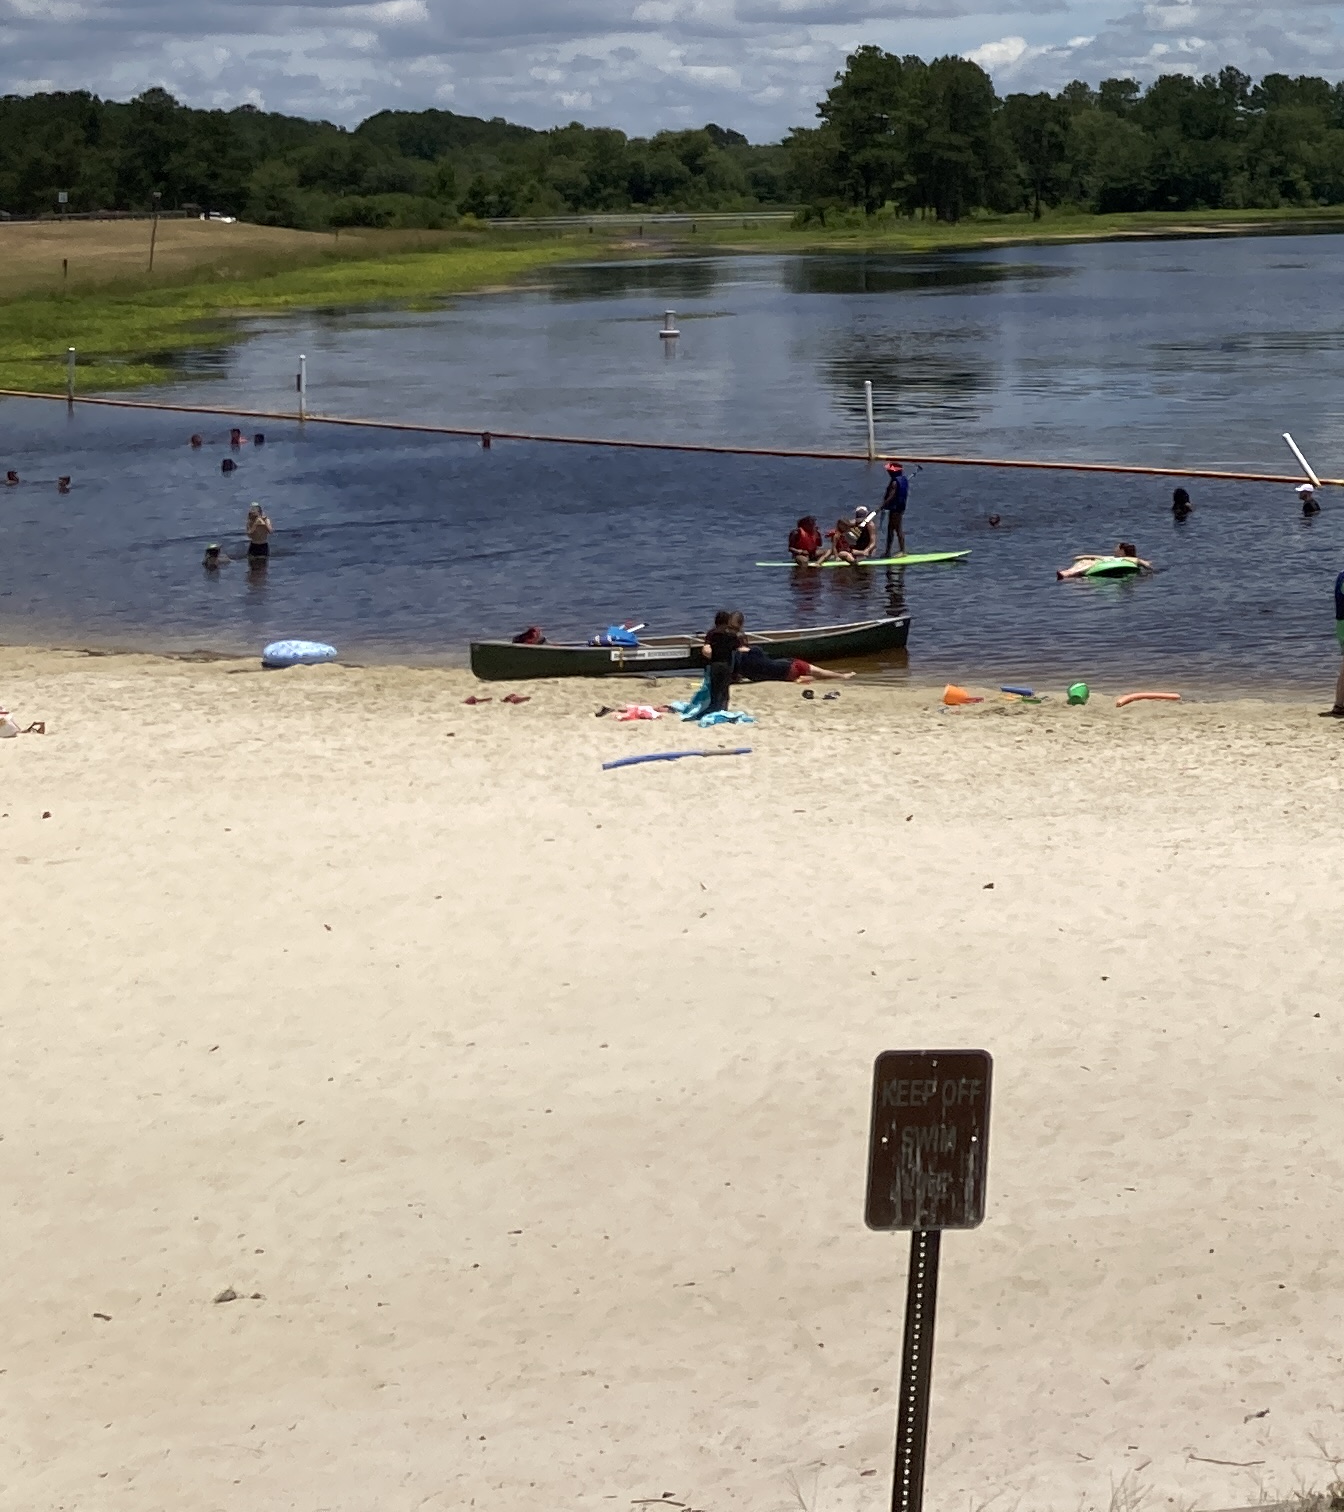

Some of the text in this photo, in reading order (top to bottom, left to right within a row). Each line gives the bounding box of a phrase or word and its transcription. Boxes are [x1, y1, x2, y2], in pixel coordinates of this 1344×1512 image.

[882, 1079, 982, 1107] KEEP OFF
[901, 1125, 957, 1153] SWIM
